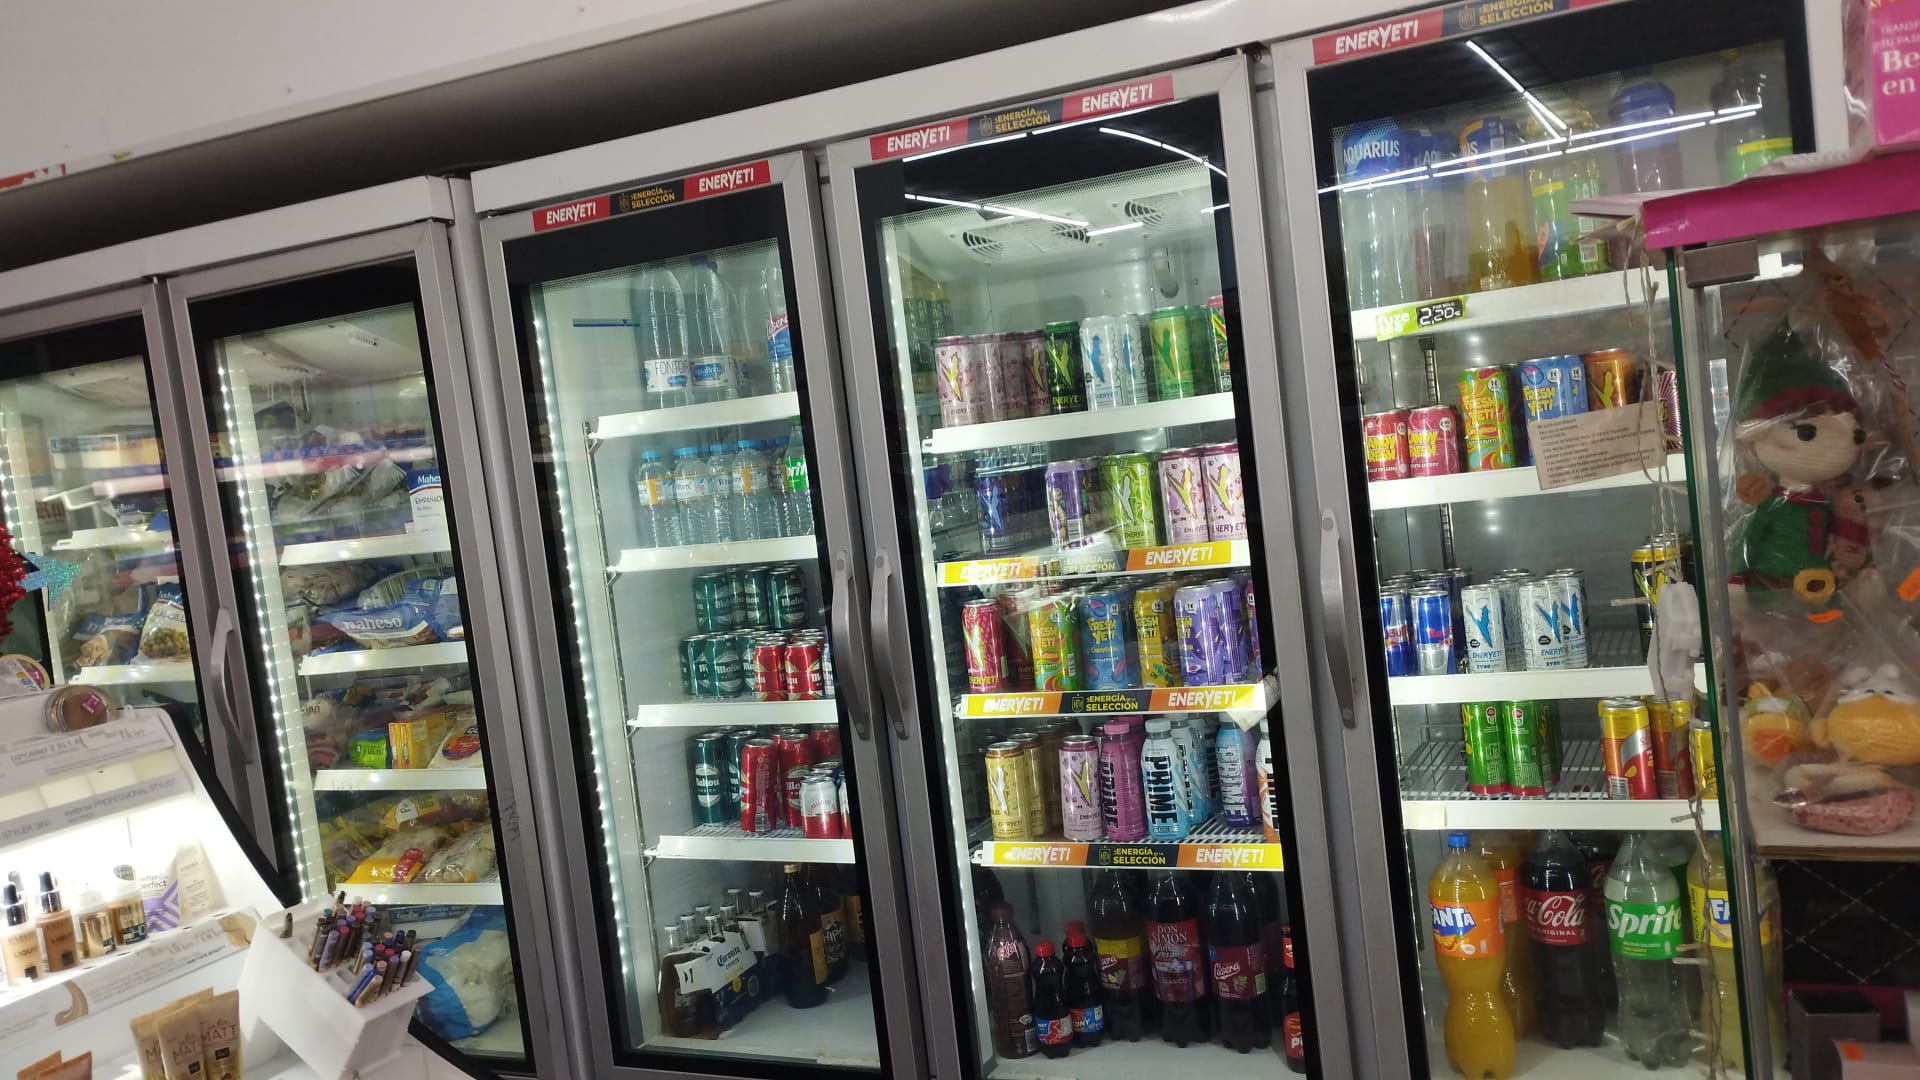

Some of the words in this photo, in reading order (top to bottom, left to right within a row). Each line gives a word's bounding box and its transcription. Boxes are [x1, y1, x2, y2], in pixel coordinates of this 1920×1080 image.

[1479, 2, 1553, 26] SELECCIÓN
[1335, 20, 1419, 55] ENERYETI
[1882, 77, 1916, 96] en
[1082, 83, 1153, 113] ENERYETI
[995, 113, 1051, 134] SELECCIÓN
[887, 125, 950, 153] ENERYETI
[1343, 140, 1400, 166] AQUARIUS
[699, 167, 754, 193] ENERYETI
[631, 192, 675, 209] SELECCIÓN
[546, 202, 596, 225] ENERYETI
[1528, 400, 1553, 417] YETI
[1144, 547, 1214, 566] ENERYETI
[1087, 617, 1116, 631] FRESH
[983, 696, 1044, 714] ENERYETI
[1085, 701, 1139, 712] SELECCIÓN
[1089, 693, 1126, 703] ENERGÍA
[1168, 690, 1237, 709] ENERYETI
[1145, 755, 1179, 826] PRIME
[1011, 846, 1071, 865] ENERYETI
[1113, 855, 1166, 866] SELECCIÓN
[1116, 847, 1153, 857] ENERGÍA
[1195, 846, 1265, 867] ENERYETI
[1152, 932, 1188, 944] SIMON
[1157, 924, 1178, 934] DON
[201, 1023, 237, 1043] MATT
